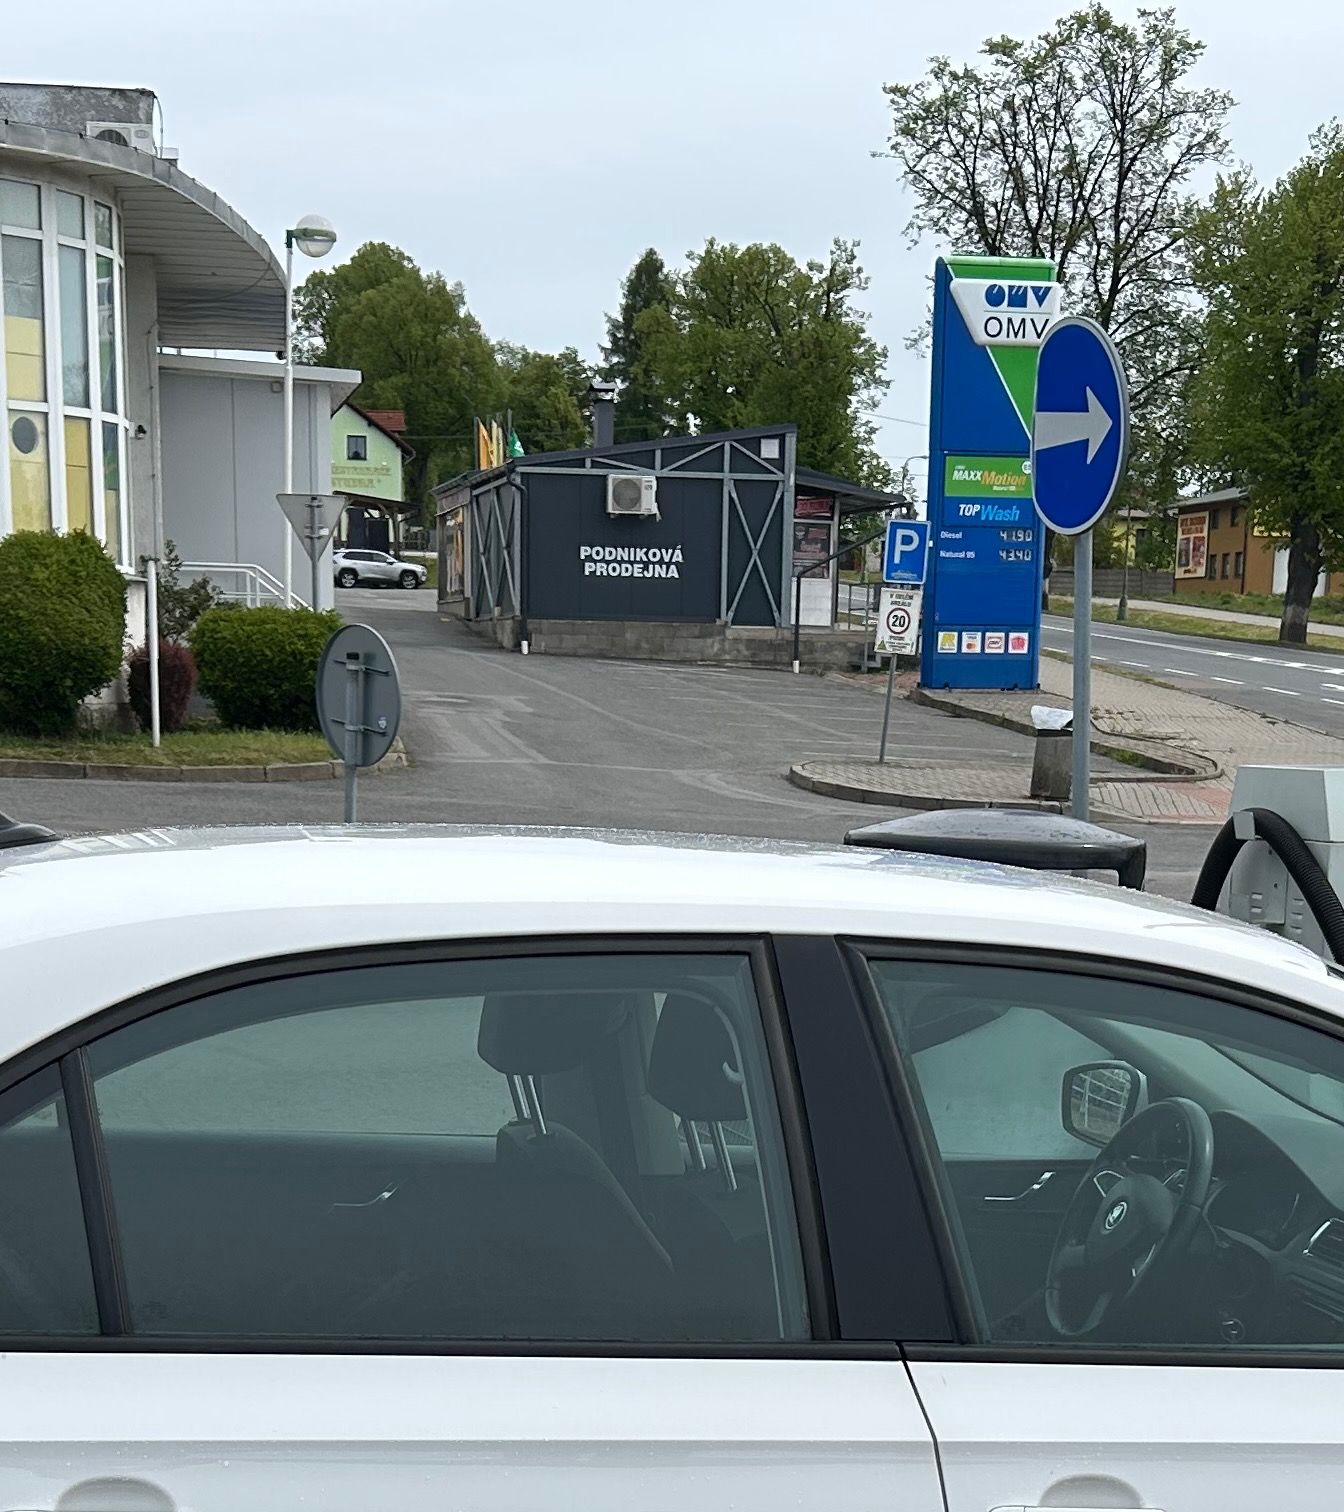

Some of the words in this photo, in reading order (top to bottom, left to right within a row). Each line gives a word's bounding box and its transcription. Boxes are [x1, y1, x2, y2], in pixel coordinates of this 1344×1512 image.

[984, 316, 1050, 340] OMV
[580, 545, 684, 563] PODNIKOVÁ
[893, 528, 920, 564] P
[584, 562, 680, 578] PRODEJNA
[891, 614, 906, 628] 20
